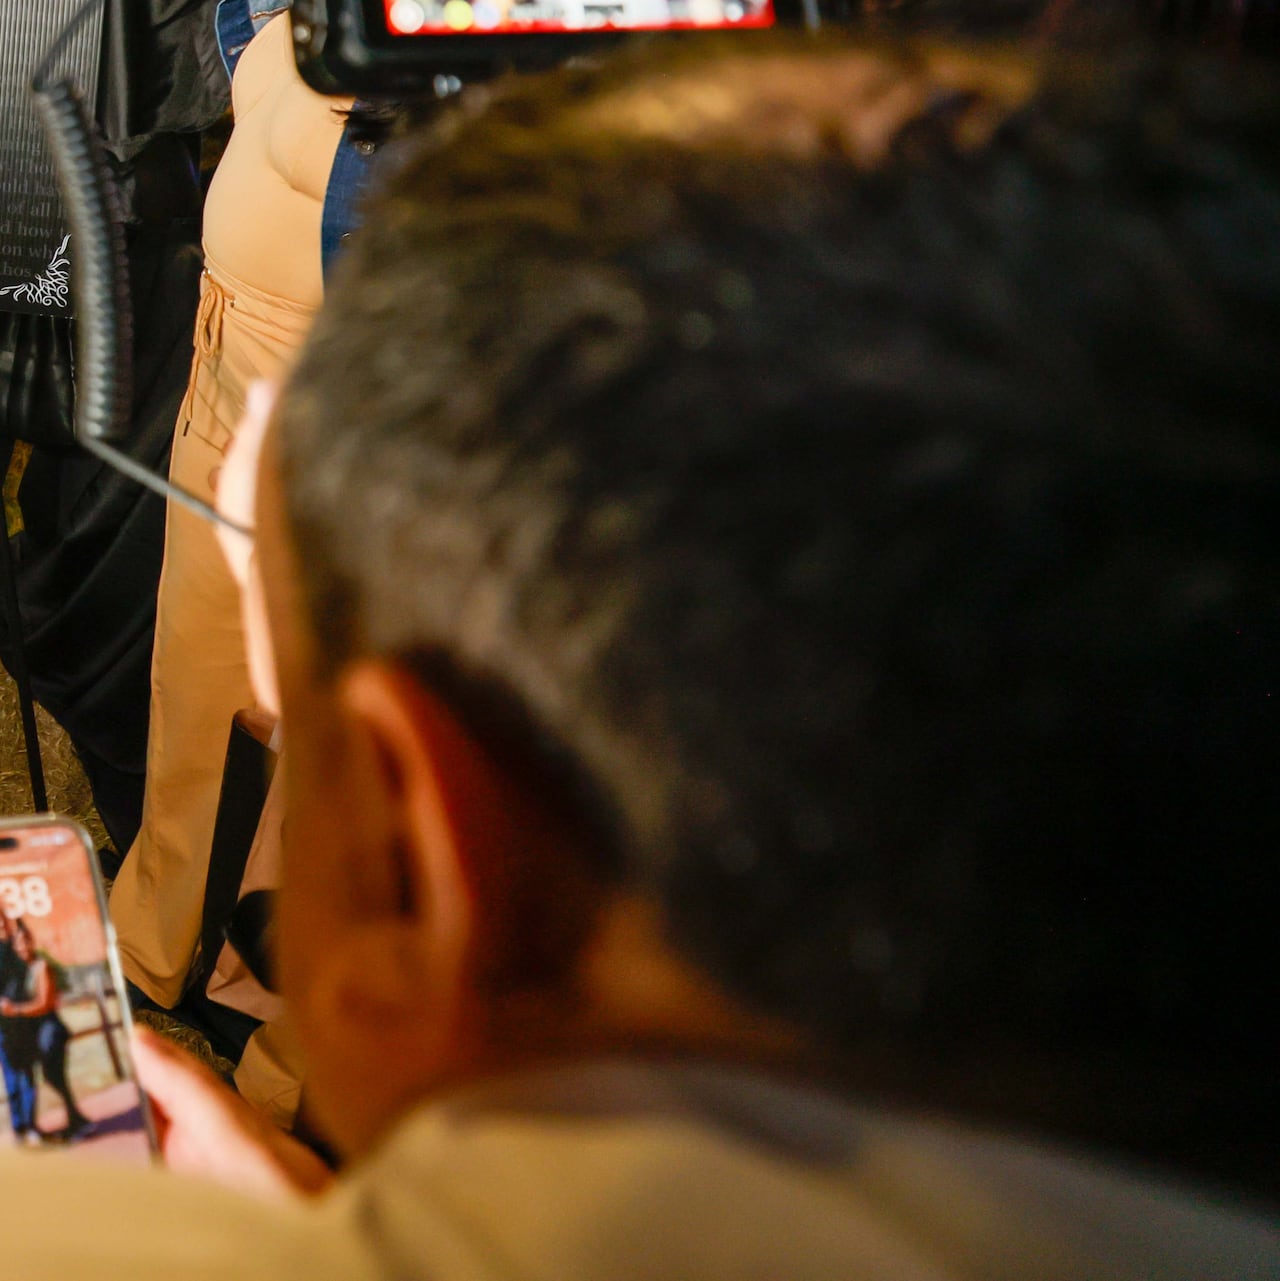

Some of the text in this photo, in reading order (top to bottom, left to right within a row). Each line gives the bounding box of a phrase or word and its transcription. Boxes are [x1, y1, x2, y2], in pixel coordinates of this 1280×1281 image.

[8, 200, 25, 215] of
[30, 202, 50, 217] all
[18, 221, 53, 238] how
